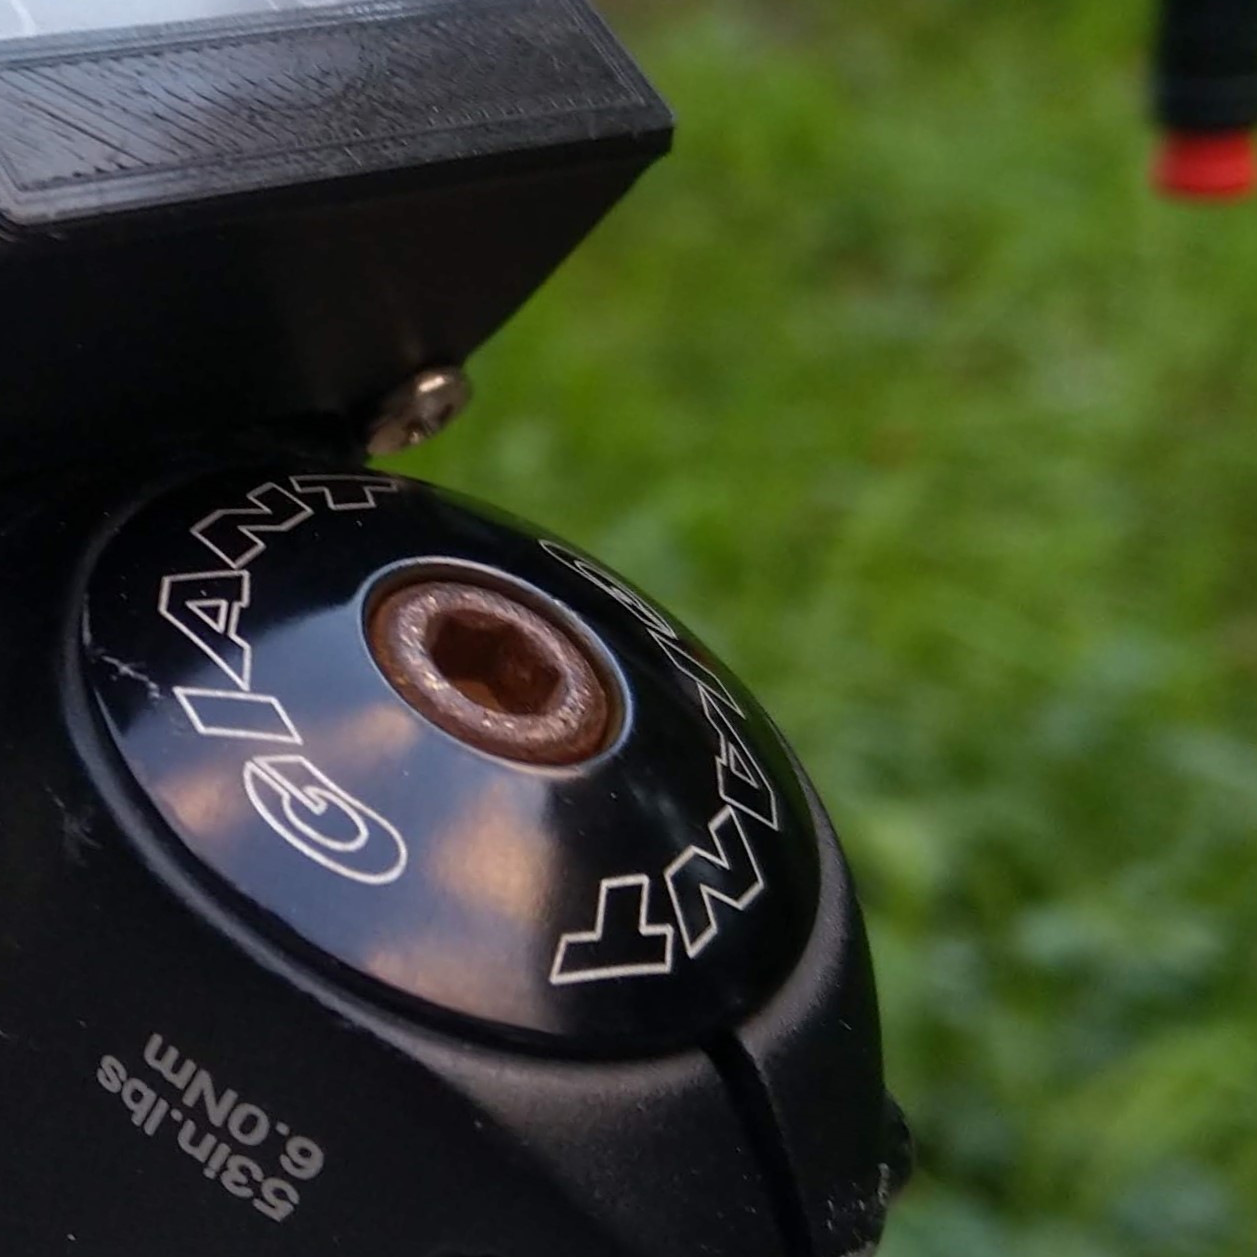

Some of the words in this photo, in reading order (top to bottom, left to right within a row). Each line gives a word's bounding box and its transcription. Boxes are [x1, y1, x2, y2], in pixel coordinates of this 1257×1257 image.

[158, 474, 408, 885] GIANT
[539, 539, 779, 985] GIANT
[143, 1032, 325, 1181] 6.0Nm
